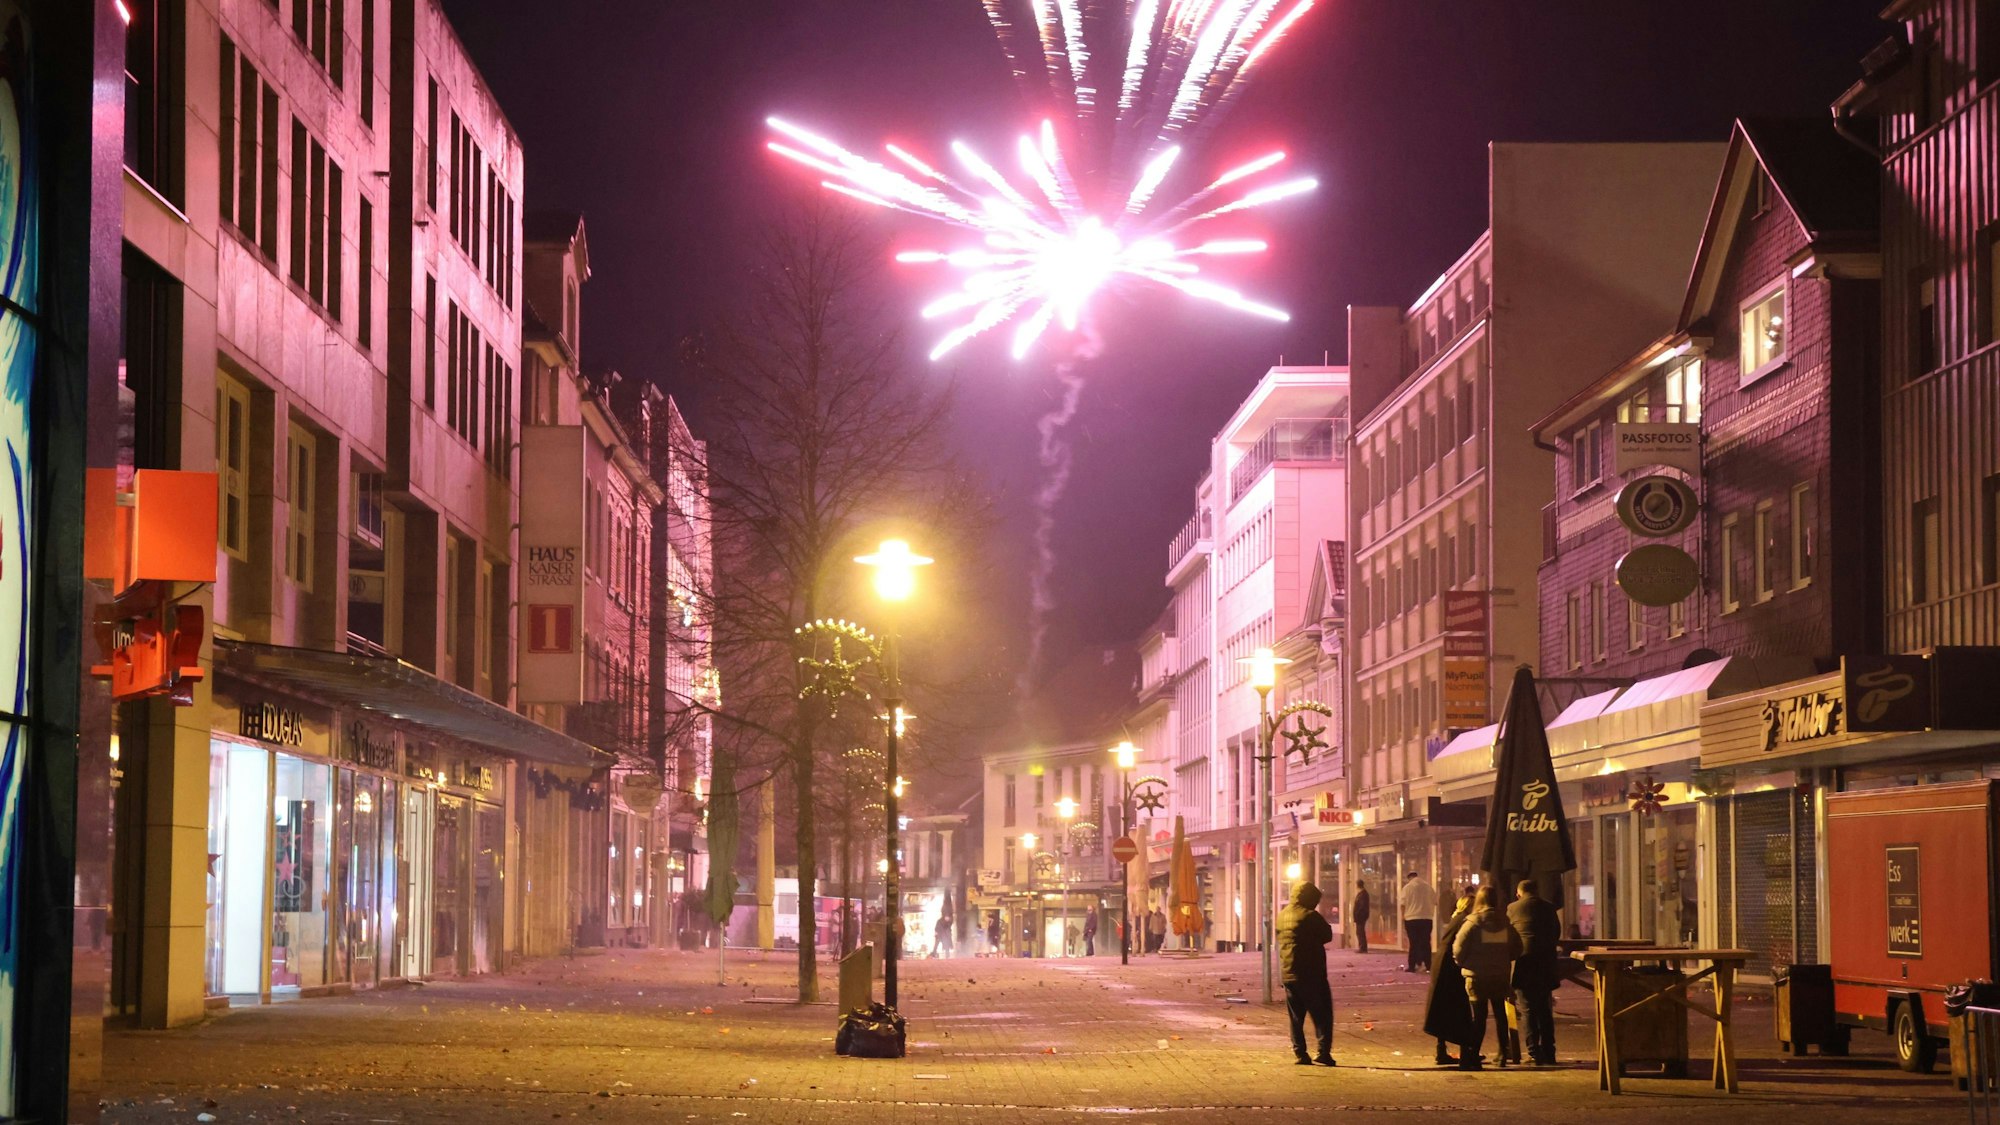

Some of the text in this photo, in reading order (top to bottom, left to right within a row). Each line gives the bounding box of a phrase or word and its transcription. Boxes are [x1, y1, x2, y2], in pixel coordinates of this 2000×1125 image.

[1622, 433, 1692, 444] PASSFOTOS
[529, 546, 576, 561] HAUS
[529, 562, 574, 575] KAISER
[528, 575, 573, 586] STRASSE
[542, 608, 559, 649] 1
[262, 702, 304, 747] DOUGLAS
[1778, 692, 1835, 743] Tchibo
[1319, 811, 1353, 823] NKD
[1888, 860, 1901, 882] Ess
